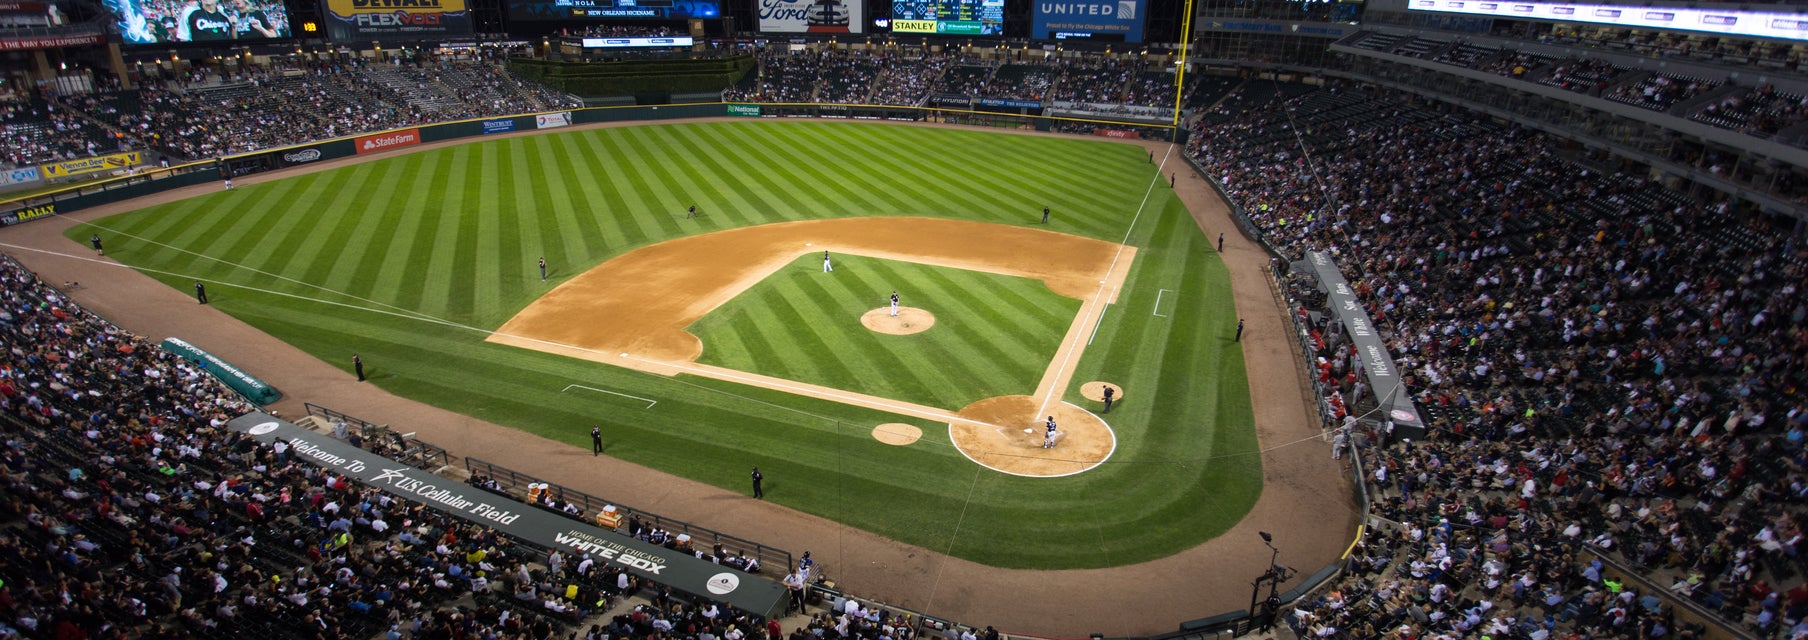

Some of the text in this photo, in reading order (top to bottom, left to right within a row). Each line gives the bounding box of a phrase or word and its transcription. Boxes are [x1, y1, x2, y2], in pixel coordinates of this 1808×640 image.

[759, 0, 812, 20] Ford
[1042, 3, 1113, 15] UNITED
[357, 14, 442, 26] FLEXVOLT
[895, 21, 934, 30] STANLEY
[4, 41, 20, 49] THE
[21, 40, 38, 48] WAY
[39, 39, 56, 47] YOU
[56, 37, 91, 46] EXPERIENCE
[484, 120, 512, 128] WINTRUST
[60, 161, 87, 170] Vienna
[88, 157, 106, 166] Beef
[1, 216, 18, 225] The
[17, 205, 54, 220] RALLY
[1353, 317, 1370, 336] White
[1367, 345, 1390, 376] Welcome
[289, 438, 366, 473] Welcome To
[469, 502, 520, 525] Field
[555, 532, 667, 575] WHITE SOX
[568, 530, 666, 564] HOME OF THE CHICAGO
